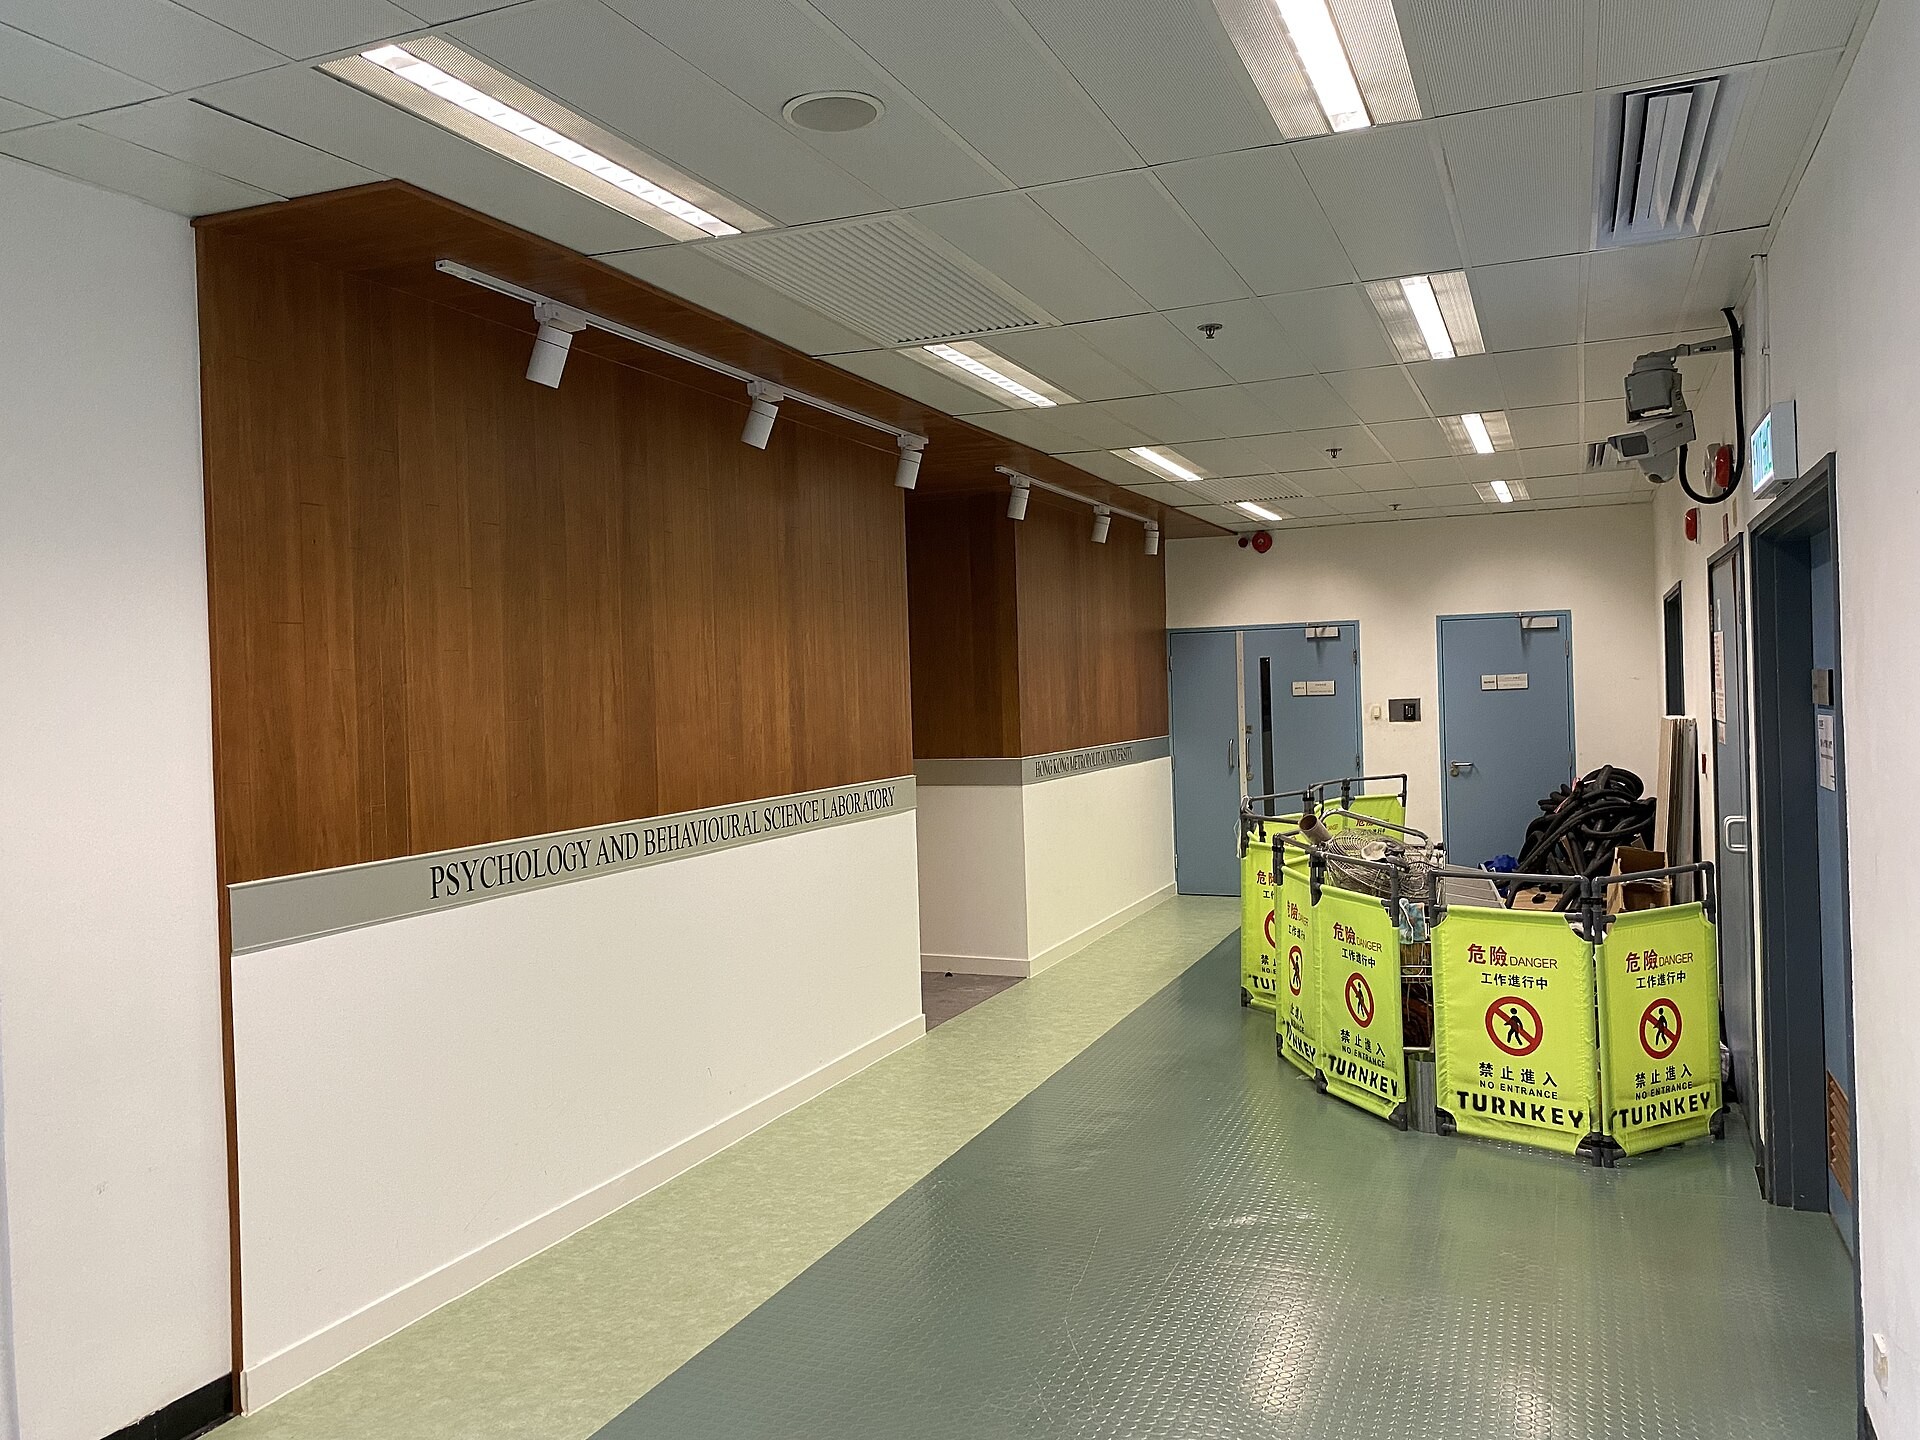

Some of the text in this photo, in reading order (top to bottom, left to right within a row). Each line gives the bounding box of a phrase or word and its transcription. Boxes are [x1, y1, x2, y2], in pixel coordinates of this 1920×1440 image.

[430, 786, 896, 899] PSYCHOLOGY AND BEHAVIOURAL SCIENCE LABORATORY
[1333, 922, 1382, 953] 危險 DANGER
[1342, 948, 1376, 969] 工作進行中
[1467, 943, 1558, 969] 危險 DANGER
[1626, 949, 1694, 973] 危險 DANGER
[1481, 972, 1548, 990] 工作進行中
[1636, 970, 1686, 989] 工作進行中
[1340, 1028, 1386, 1058] 禁止進入
[1341, 1045, 1386, 1069] NO ENTRANCE
[1328, 1053, 1398, 1097] TURNKEY
[1479, 1062, 1558, 1088] 禁止進入
[1634, 1063, 1693, 1089] 禁止進入
[1479, 1080, 1558, 1100] NO ENTRANCE
[1635, 1081, 1693, 1101] NO ENTRANCE
[1456, 1090, 1584, 1129] TURNKEY
[1618, 1091, 1711, 1129] TURNKEY
